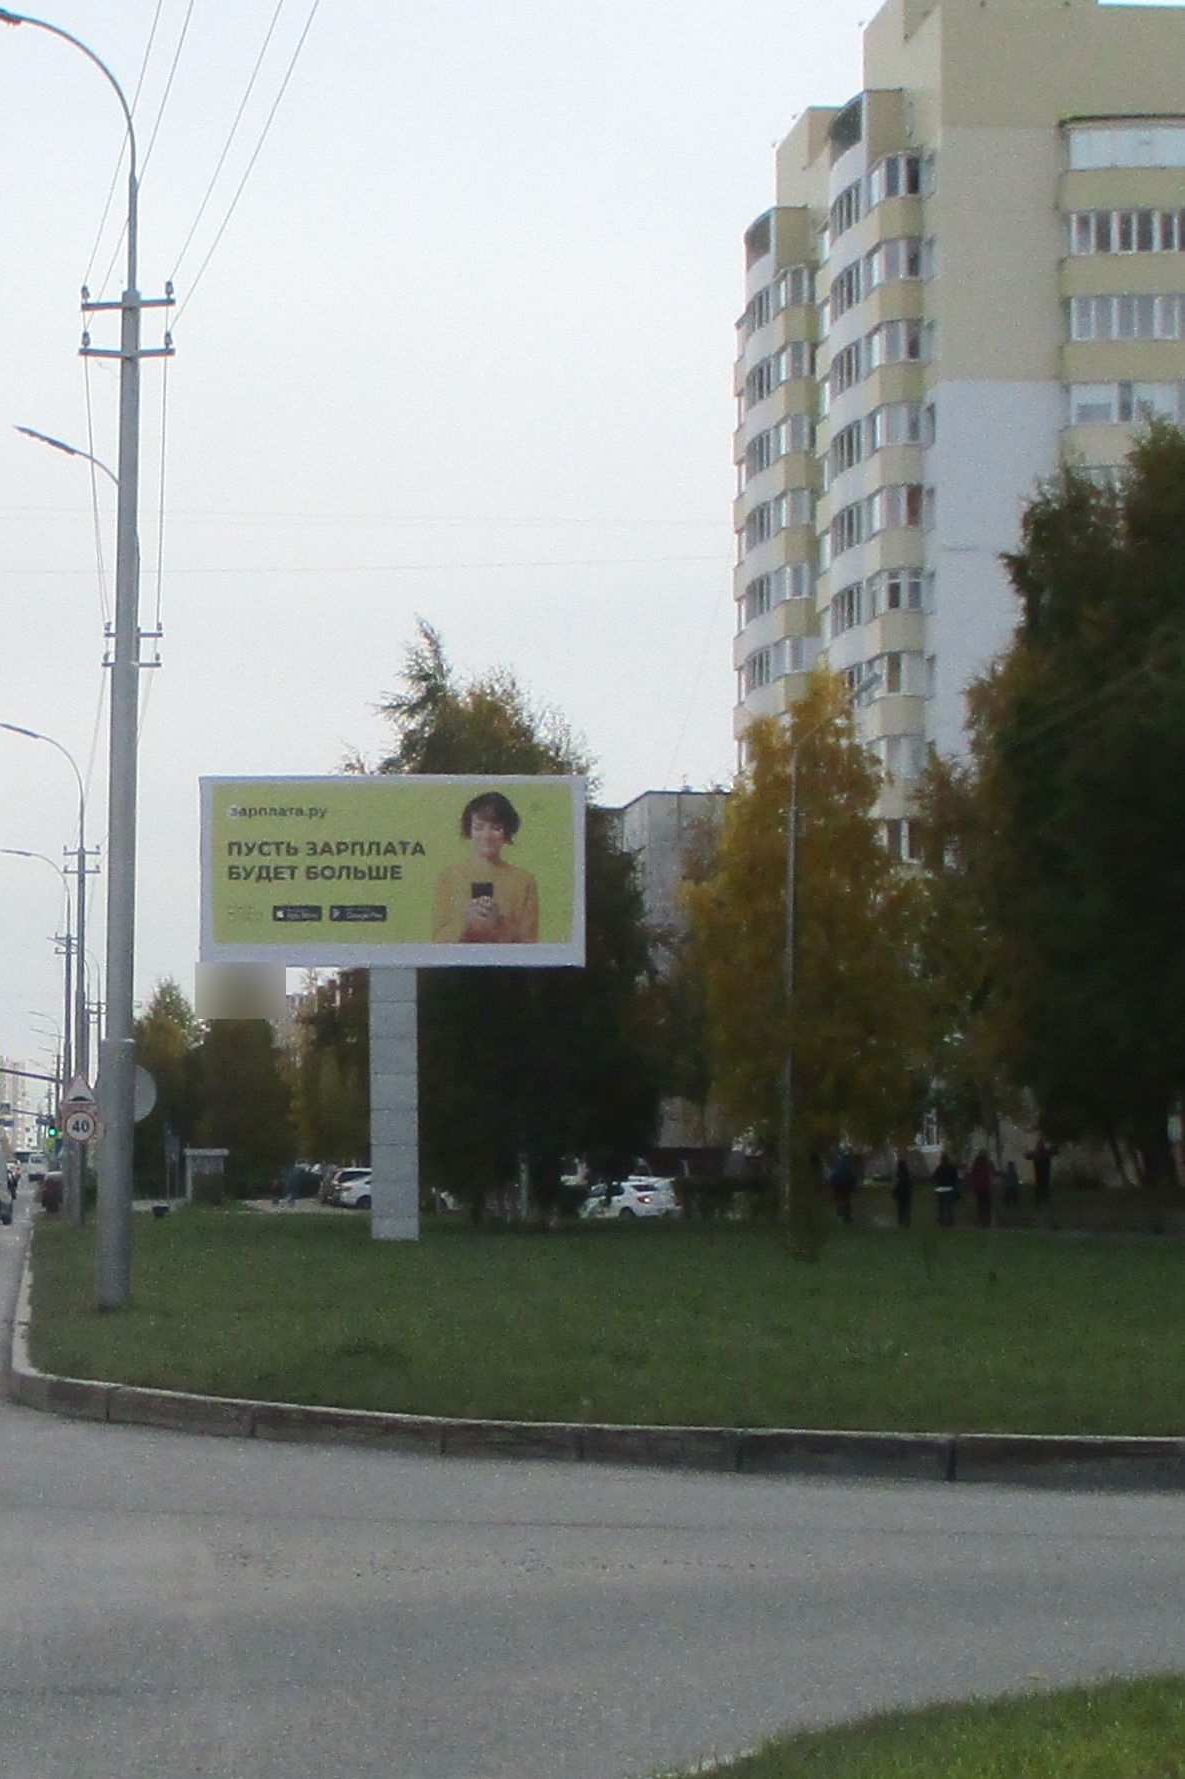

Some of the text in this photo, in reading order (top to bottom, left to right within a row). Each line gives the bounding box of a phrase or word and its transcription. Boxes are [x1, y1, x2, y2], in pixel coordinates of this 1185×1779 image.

[228, 806, 327, 820] зарплата.ру
[227, 841, 426, 857] ПУСТЬ ЗАРПЛАТА
[227, 865, 402, 882] БУДЕТ БОЛЬШЕ
[72, 1120, 89, 1133] 40
